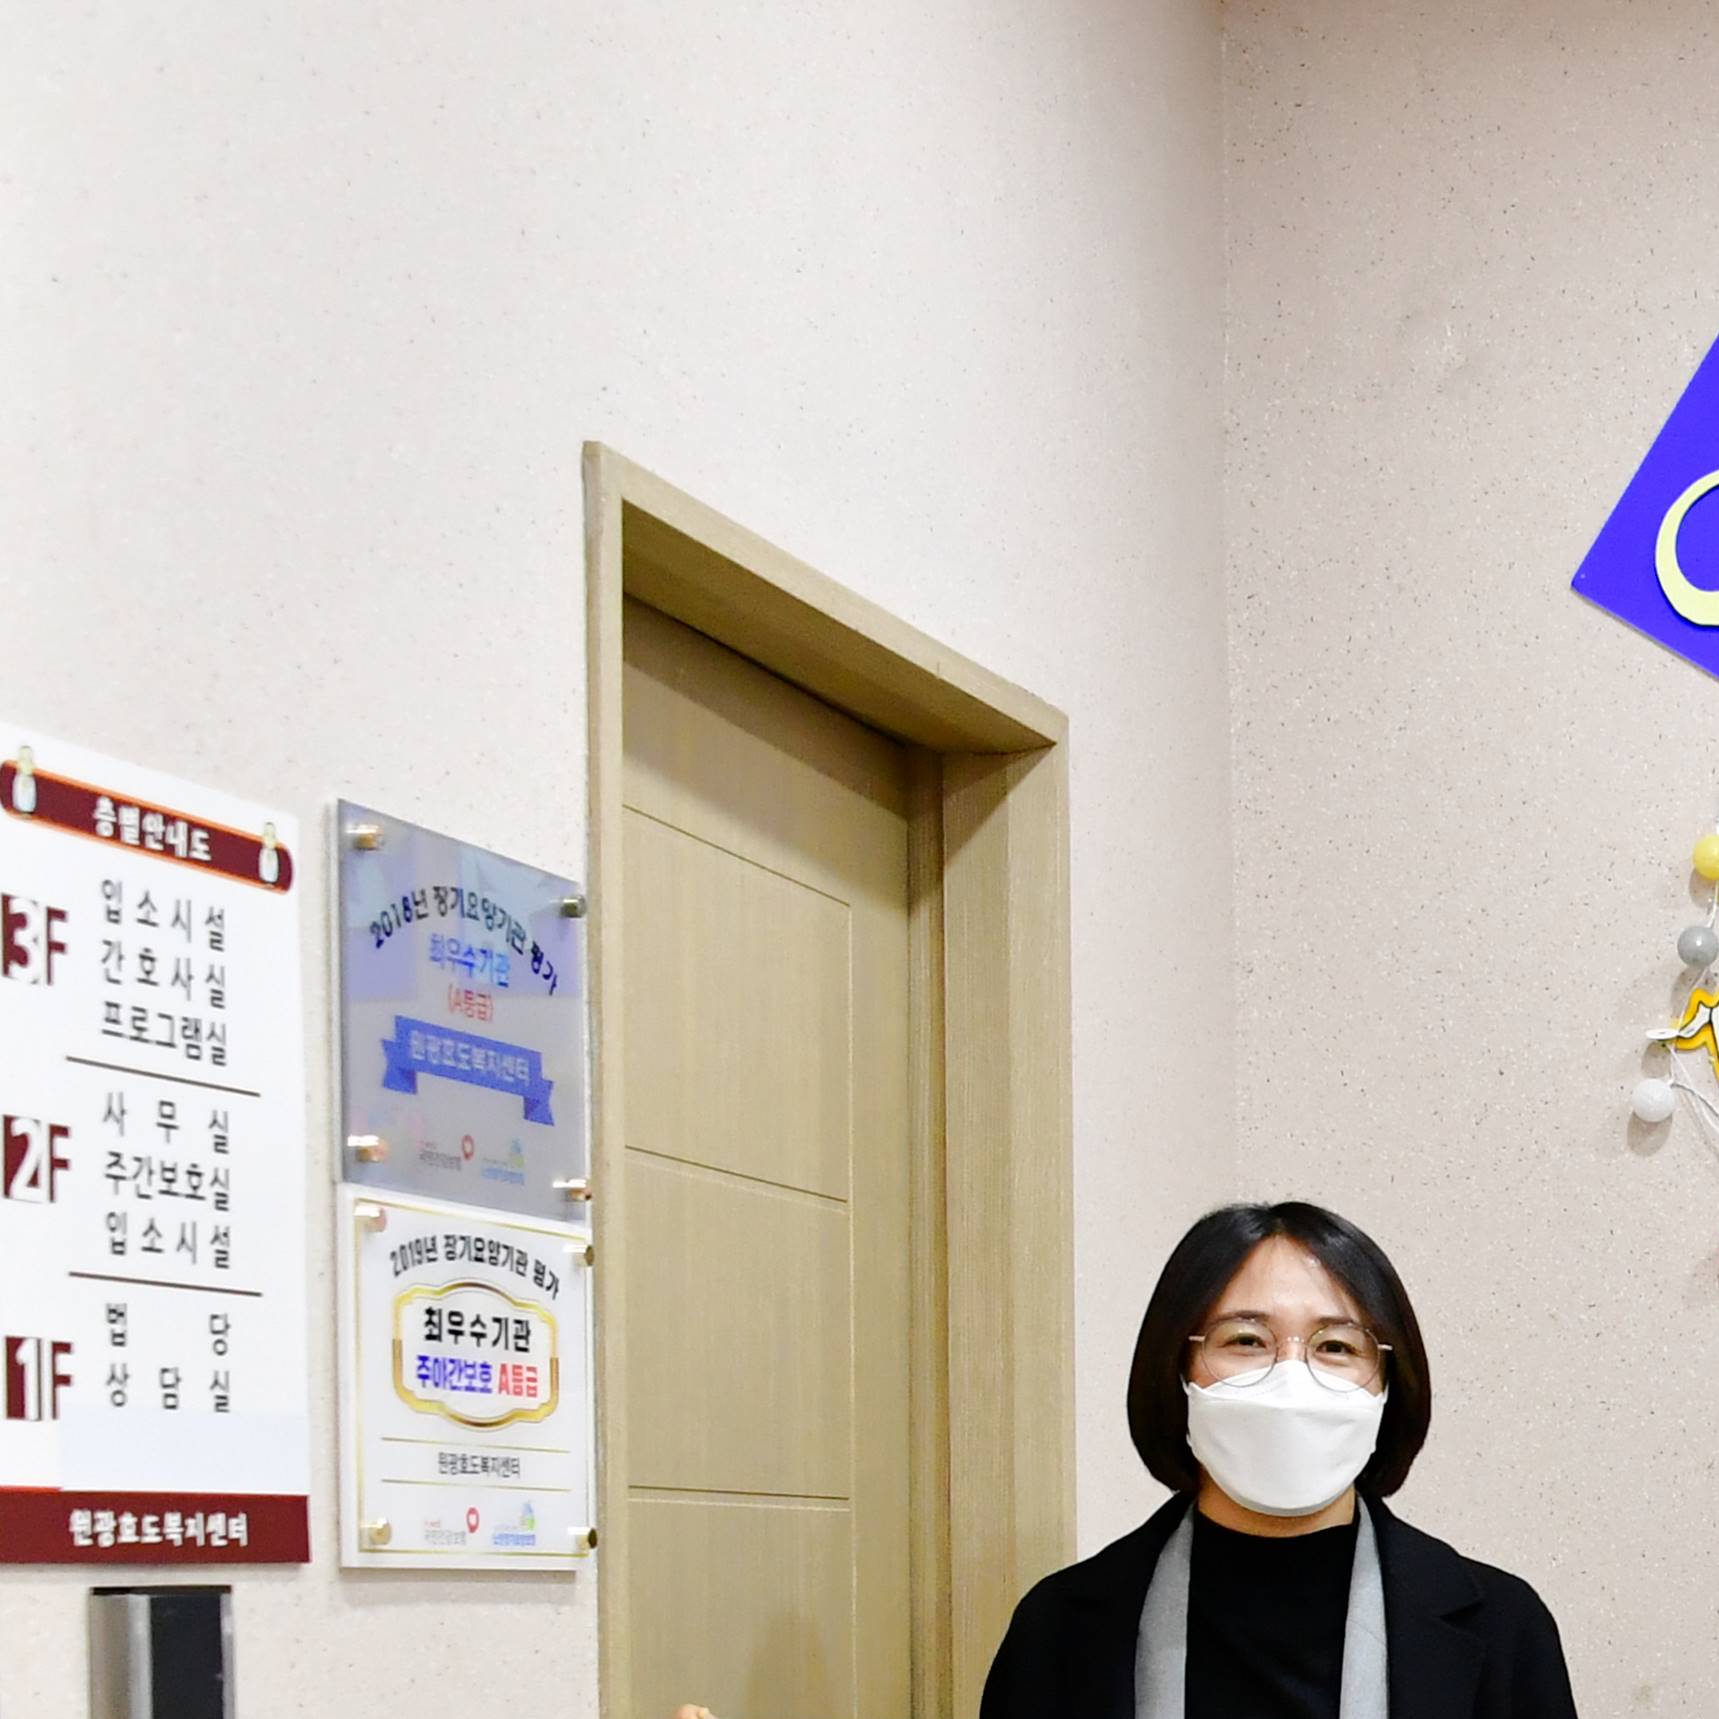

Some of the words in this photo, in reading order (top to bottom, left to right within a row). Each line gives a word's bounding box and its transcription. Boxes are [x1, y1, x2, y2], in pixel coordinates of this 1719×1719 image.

[93, 795, 211, 861] 층별안내도
[2, 893, 68, 985] 3F
[369, 890, 429, 949] 2018년
[433, 885, 527, 955] 장기요양기관
[531, 940, 558, 996] 평가
[429, 932, 511, 988] 최우수기관
[101, 1000, 226, 1066] 프로그램실
[3, 1115, 71, 1204] 2F
[104, 1151, 230, 1212] 주간보호실
[390, 1235, 438, 1278] 2019년
[443, 1234, 529, 1278] 장기요양기관
[533, 1259, 560, 1300] 평가
[424, 1307, 531, 1353] 최우수기관
[5, 1335, 74, 1421] 1F
[417, 1355, 493, 1394] 주야간보호
[499, 1362, 538, 1398] A등급
[69, 1508, 249, 1548] 원광효도복지센터
